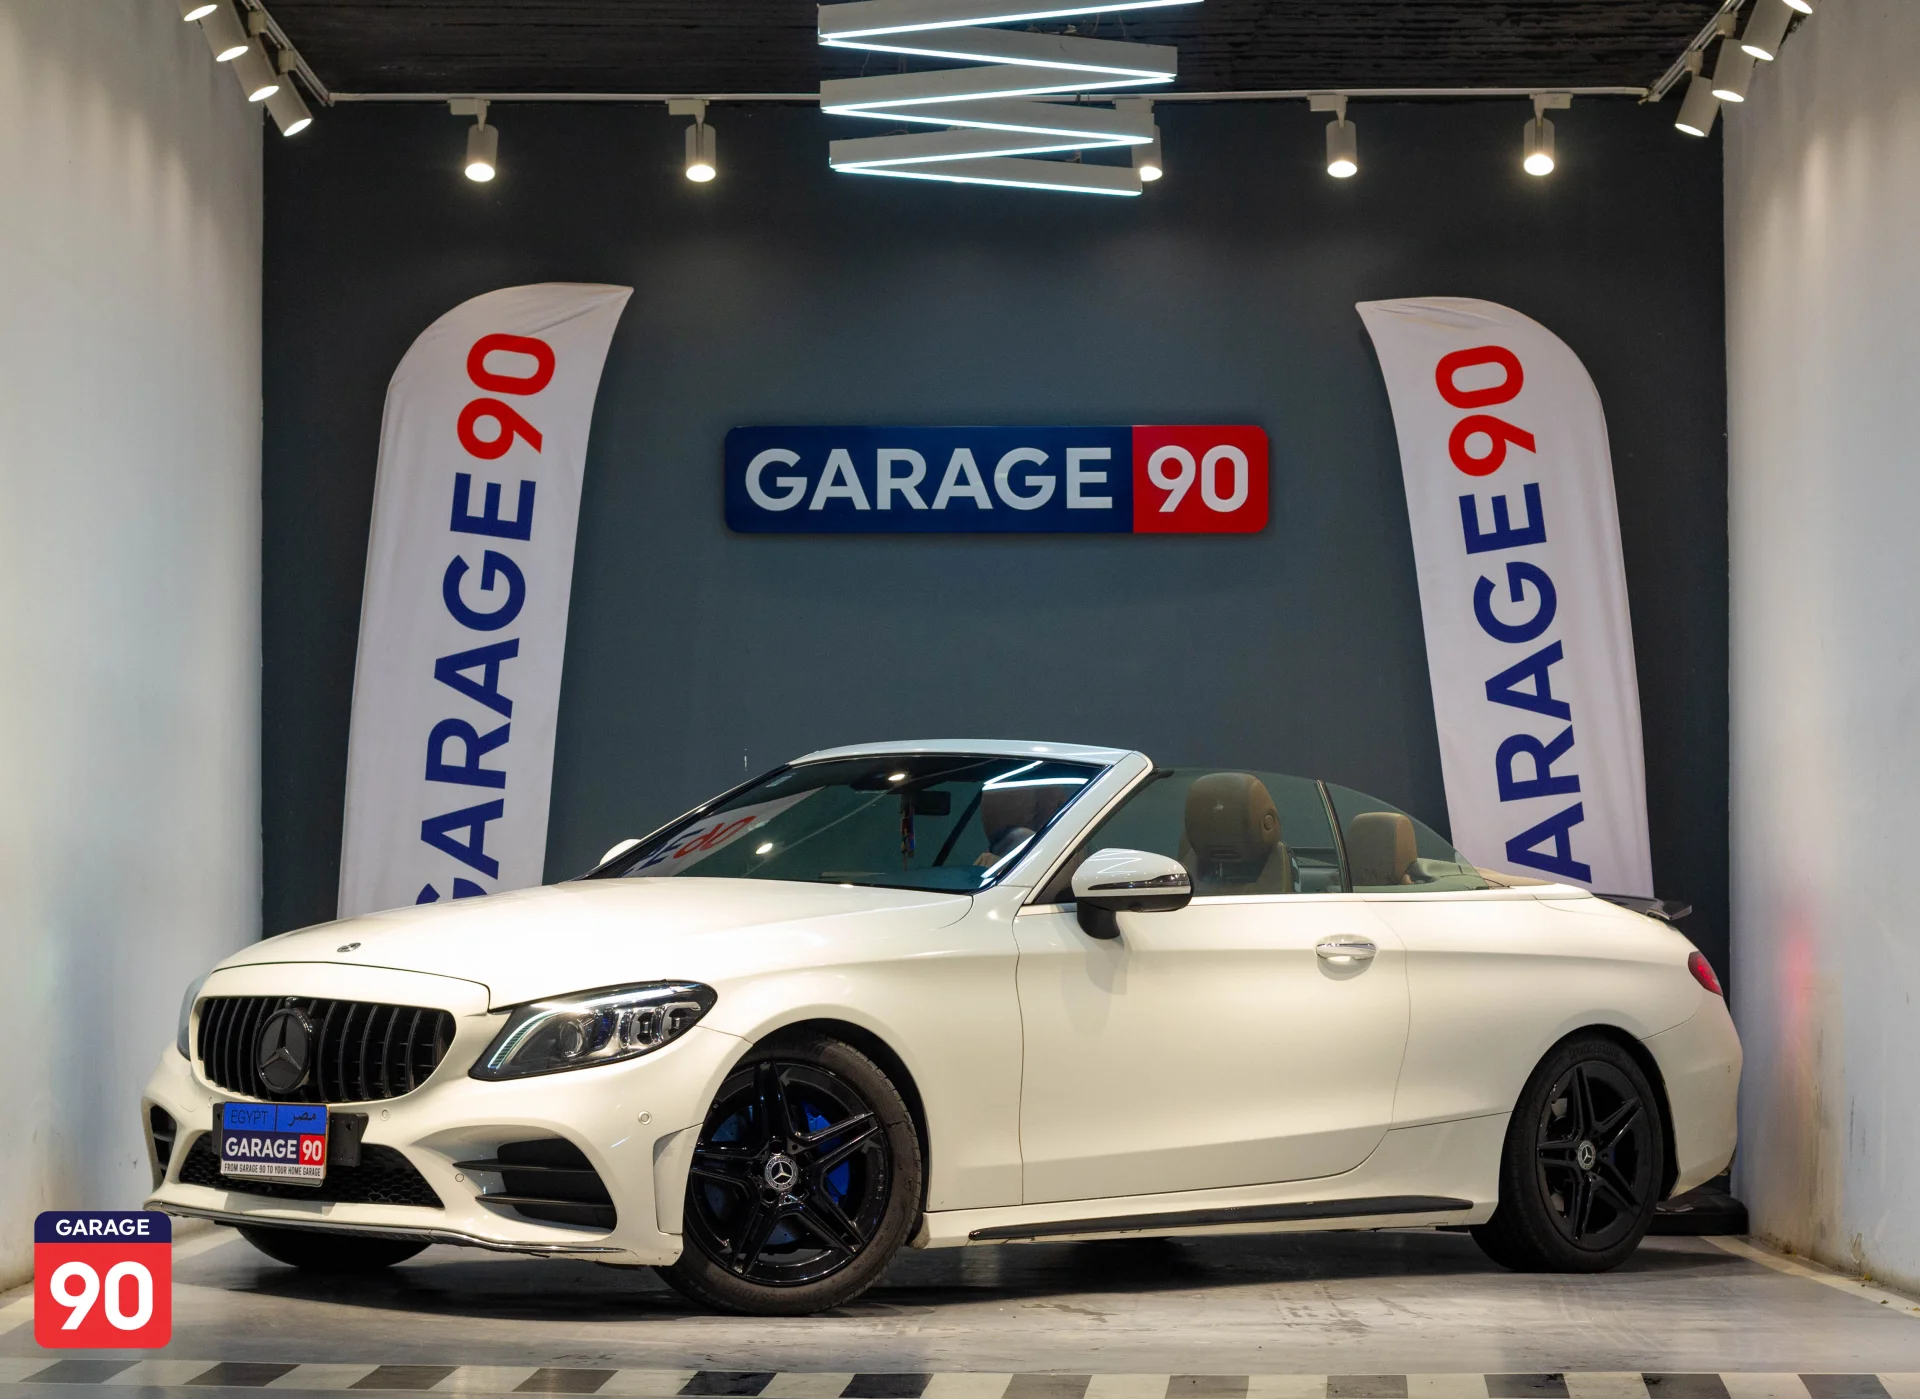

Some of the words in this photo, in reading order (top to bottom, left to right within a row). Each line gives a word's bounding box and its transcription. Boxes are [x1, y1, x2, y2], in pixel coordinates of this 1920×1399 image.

[457, 333, 557, 461] 90
[1435, 345, 1537, 478] 90
[745, 447, 1113, 511] GARAGE
[1147, 445, 1249, 513] 90
[418, 474, 537, 904] ARAGE
[1459, 483, 1591, 882] ARAGE
[225, 1137, 297, 1159] GARAGE
[302, 1140, 322, 1161] 90
[231, 1109, 268, 1125] EGYPT
[288, 1112, 317, 1127] مصر
[225, 1163, 239, 1172] FROM
[240, 1164, 259, 1173] GARAGE
[260, 1165, 266, 1174] 90
[267, 1166, 274, 1174] TO
[275, 1166, 287, 1175] YOUR
[288, 1166, 302, 1176] HOME
[303, 1167, 321, 1177] GARAGE
